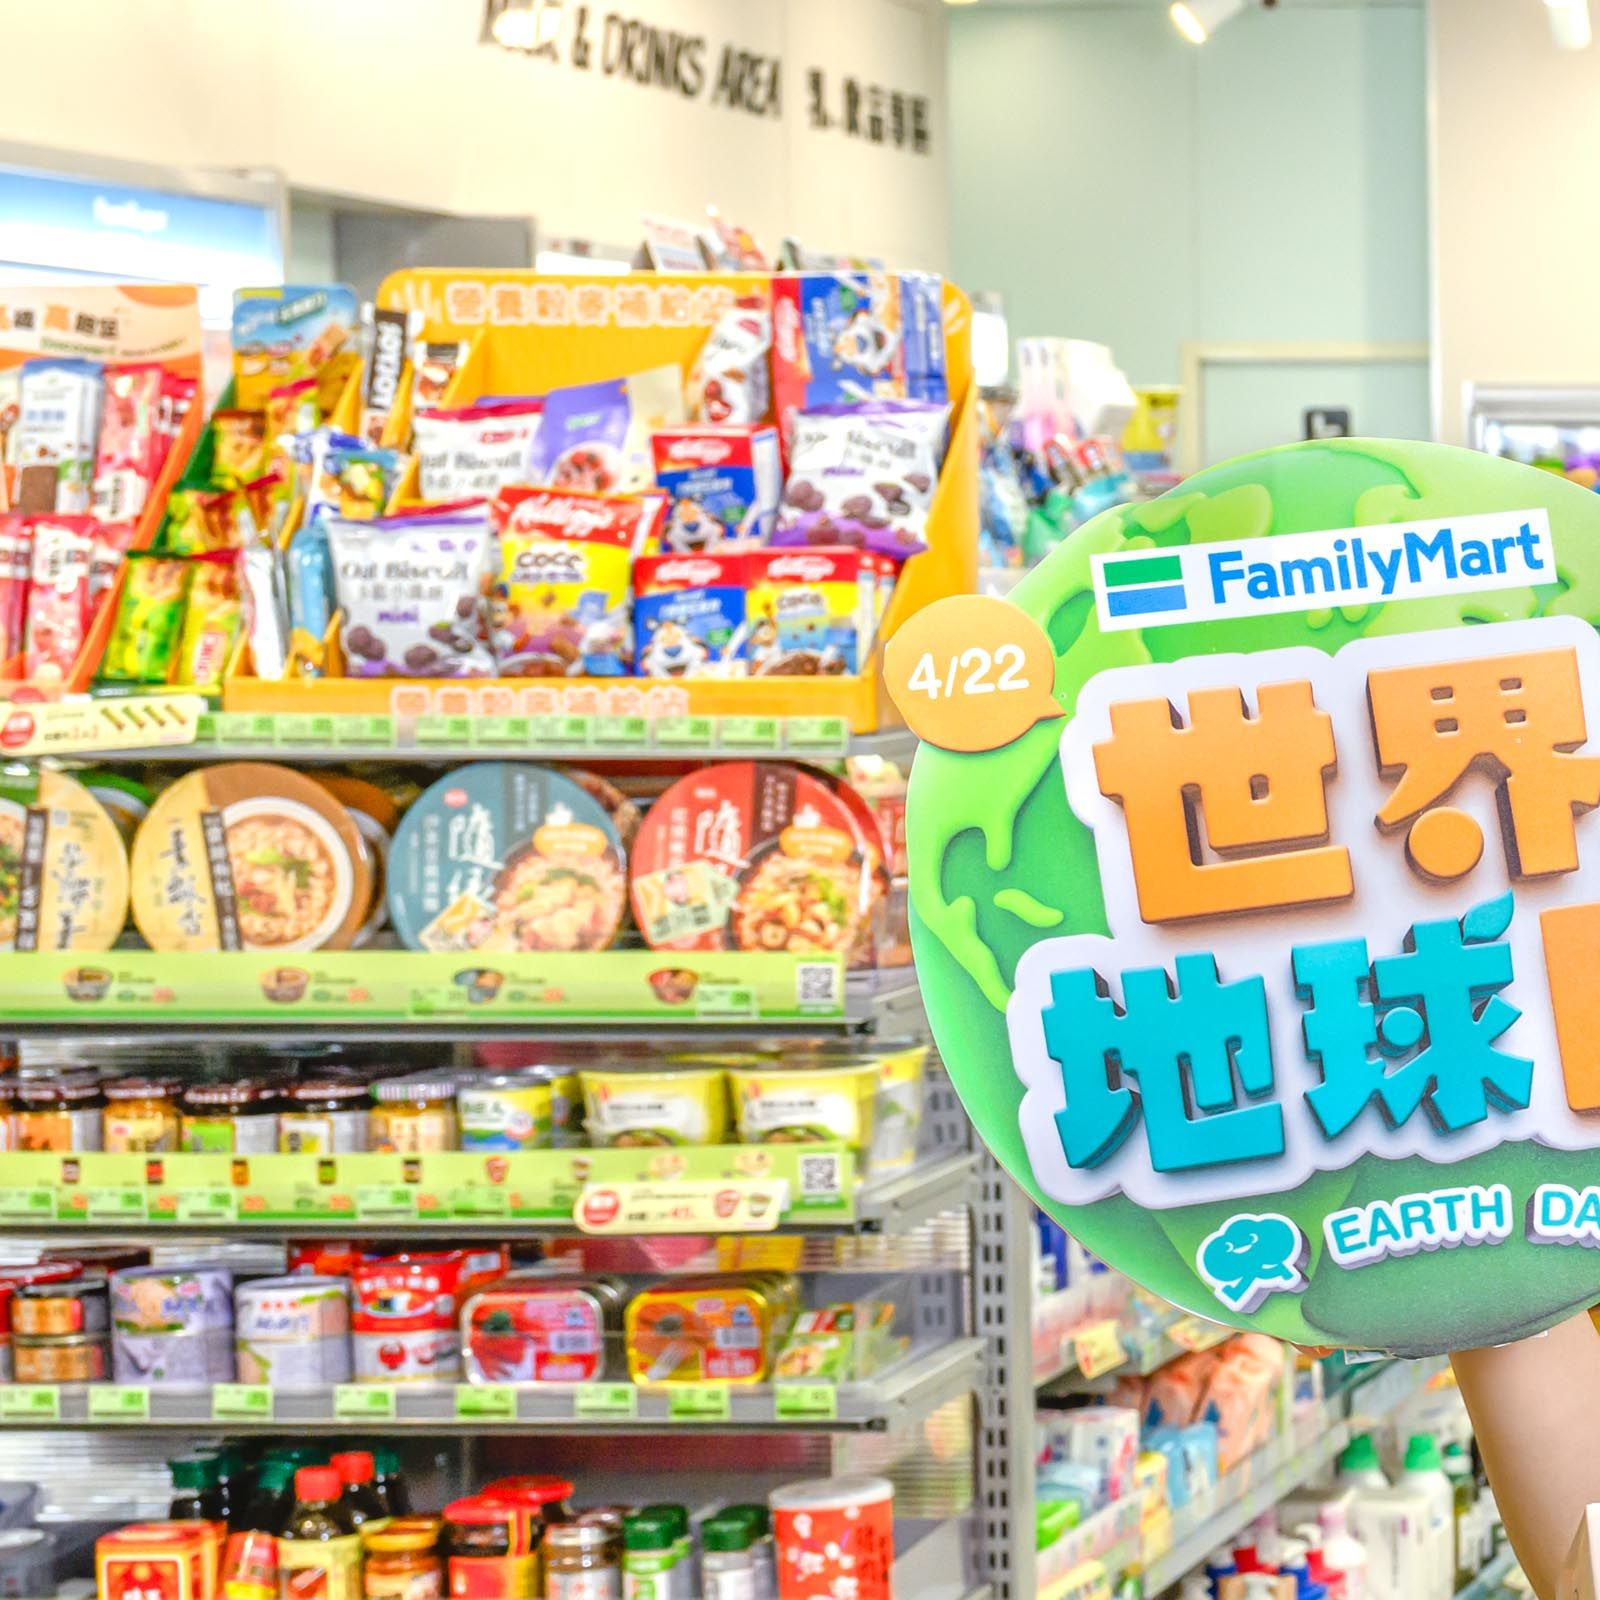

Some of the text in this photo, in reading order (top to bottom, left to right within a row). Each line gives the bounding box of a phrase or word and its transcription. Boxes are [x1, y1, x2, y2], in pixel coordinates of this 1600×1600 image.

[1208, 520, 1546, 606] FamilyMart
[907, 644, 1030, 702] 4/22
[1334, 1190, 1507, 1256] EARTH
